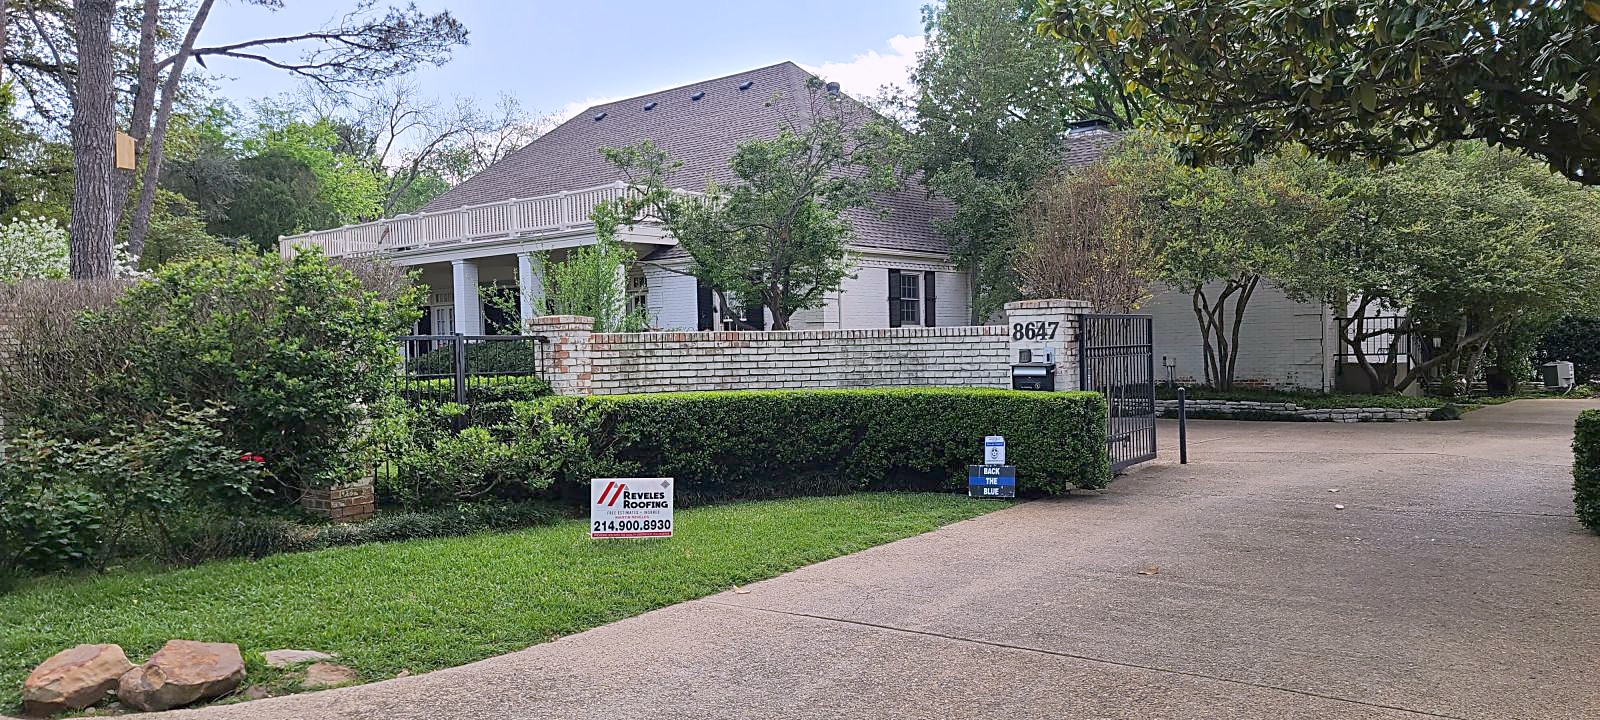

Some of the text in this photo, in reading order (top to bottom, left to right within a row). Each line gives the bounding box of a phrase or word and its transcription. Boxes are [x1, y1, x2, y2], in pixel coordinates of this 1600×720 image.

[1012, 321, 1059, 341] 8647
[623, 491, 665, 500] REVELES
[623, 500, 669, 509] ROOFING
[594, 520, 671, 532] 214.900.8930
